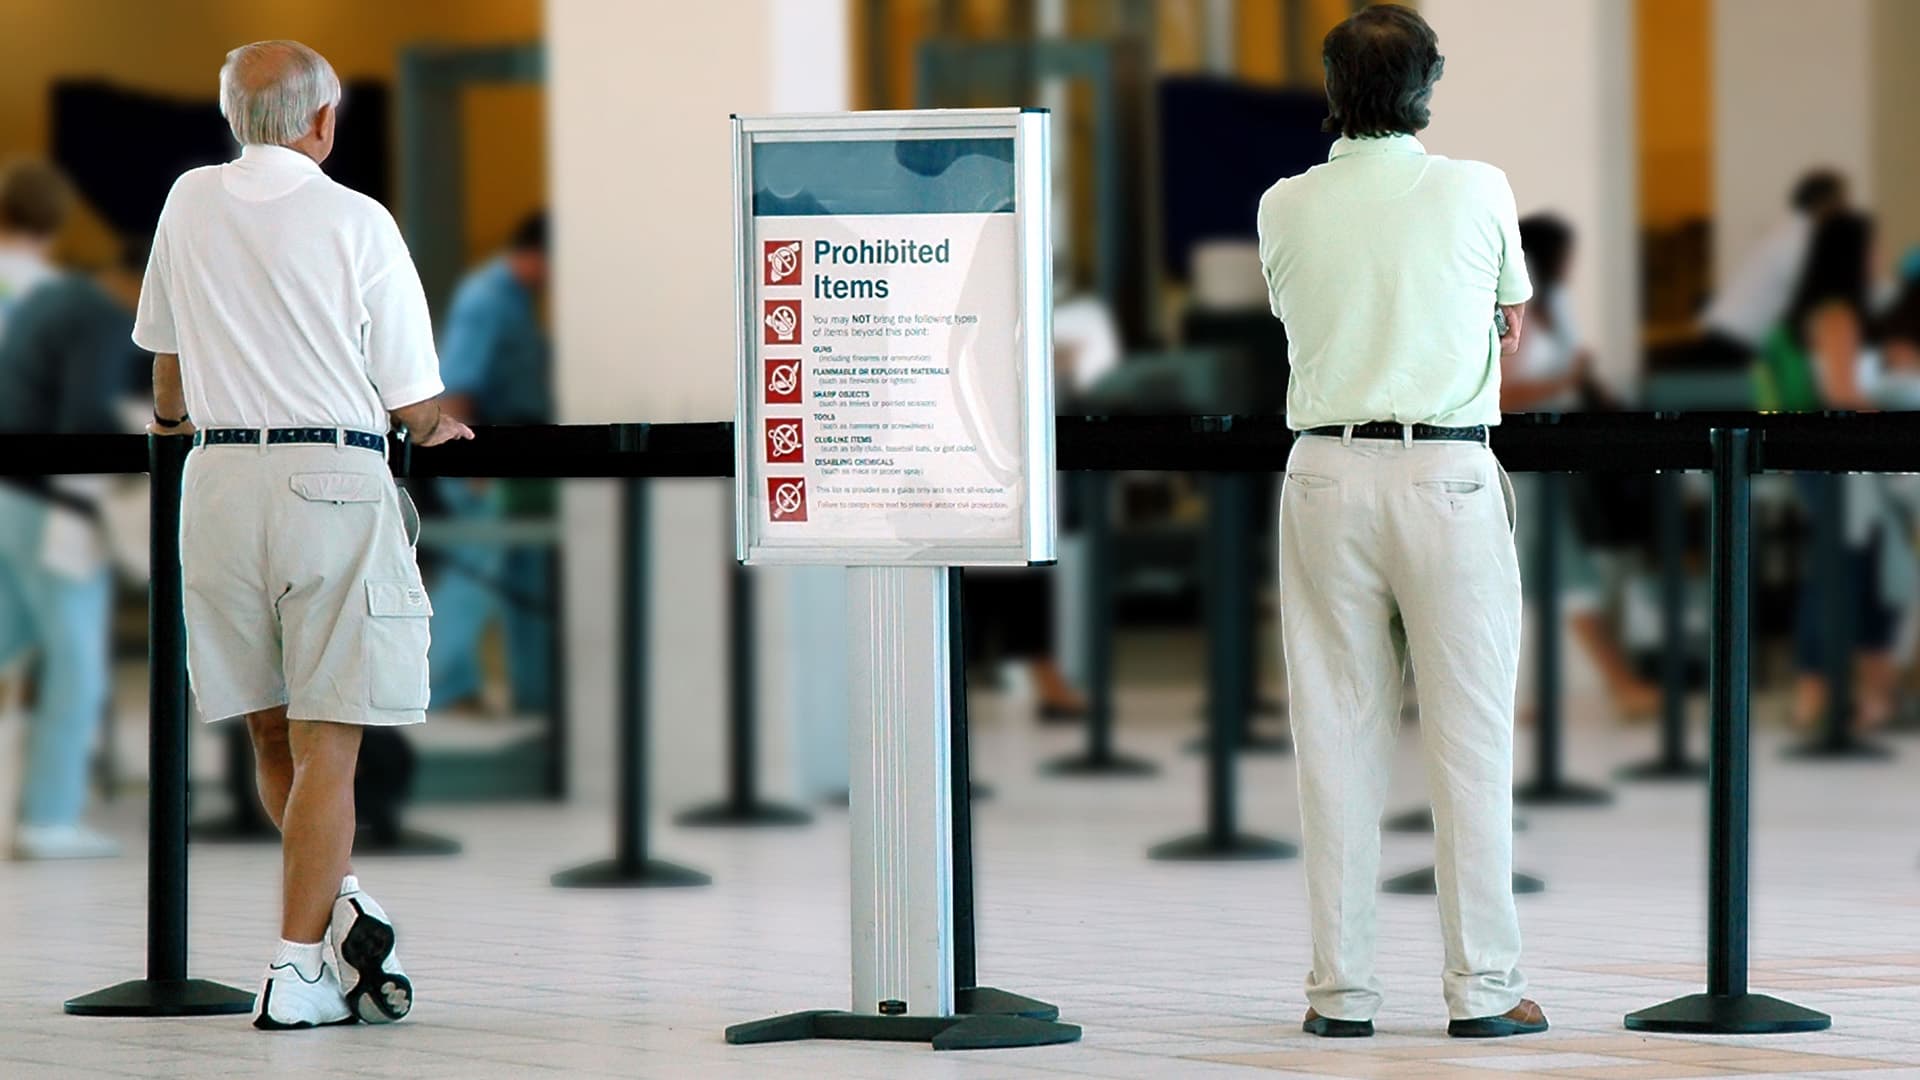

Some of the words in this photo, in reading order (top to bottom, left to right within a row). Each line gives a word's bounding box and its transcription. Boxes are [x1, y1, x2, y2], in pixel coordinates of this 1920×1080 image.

[814, 238, 949, 264] Prohibited
[814, 274, 889, 299] Items
[813, 314, 828, 324] You
[832, 316, 849, 326] may
[852, 314, 870, 324] NOT
[873, 315, 896, 326] bring
[898, 314, 912, 324] the
[914, 314, 952, 326] following
[954, 315, 978, 326] types
[812, 328, 822, 337] of
[824, 328, 849, 337] items
[851, 328, 883, 339] beyond
[886, 327, 902, 337] this
[812, 345, 832, 353] GUNS
[852, 354, 880, 362] firearms
[812, 367, 857, 376] FLAMMABLE
[858, 367, 869, 376] OR
[871, 367, 909, 376] EXPLOSIVE
[911, 367, 950, 375] MATERIALS
[849, 377, 879, 385] fireworks
[813, 390, 836, 398] SHARP
[838, 390, 870, 398] OBJECTS
[813, 413, 836, 421] TOOLS
[814, 435, 849, 443] CLUB-LIKE
[850, 435, 872, 443] ITEMS
[814, 458, 853, 466] DISABLING
[854, 458, 894, 466] CHEMICALS
